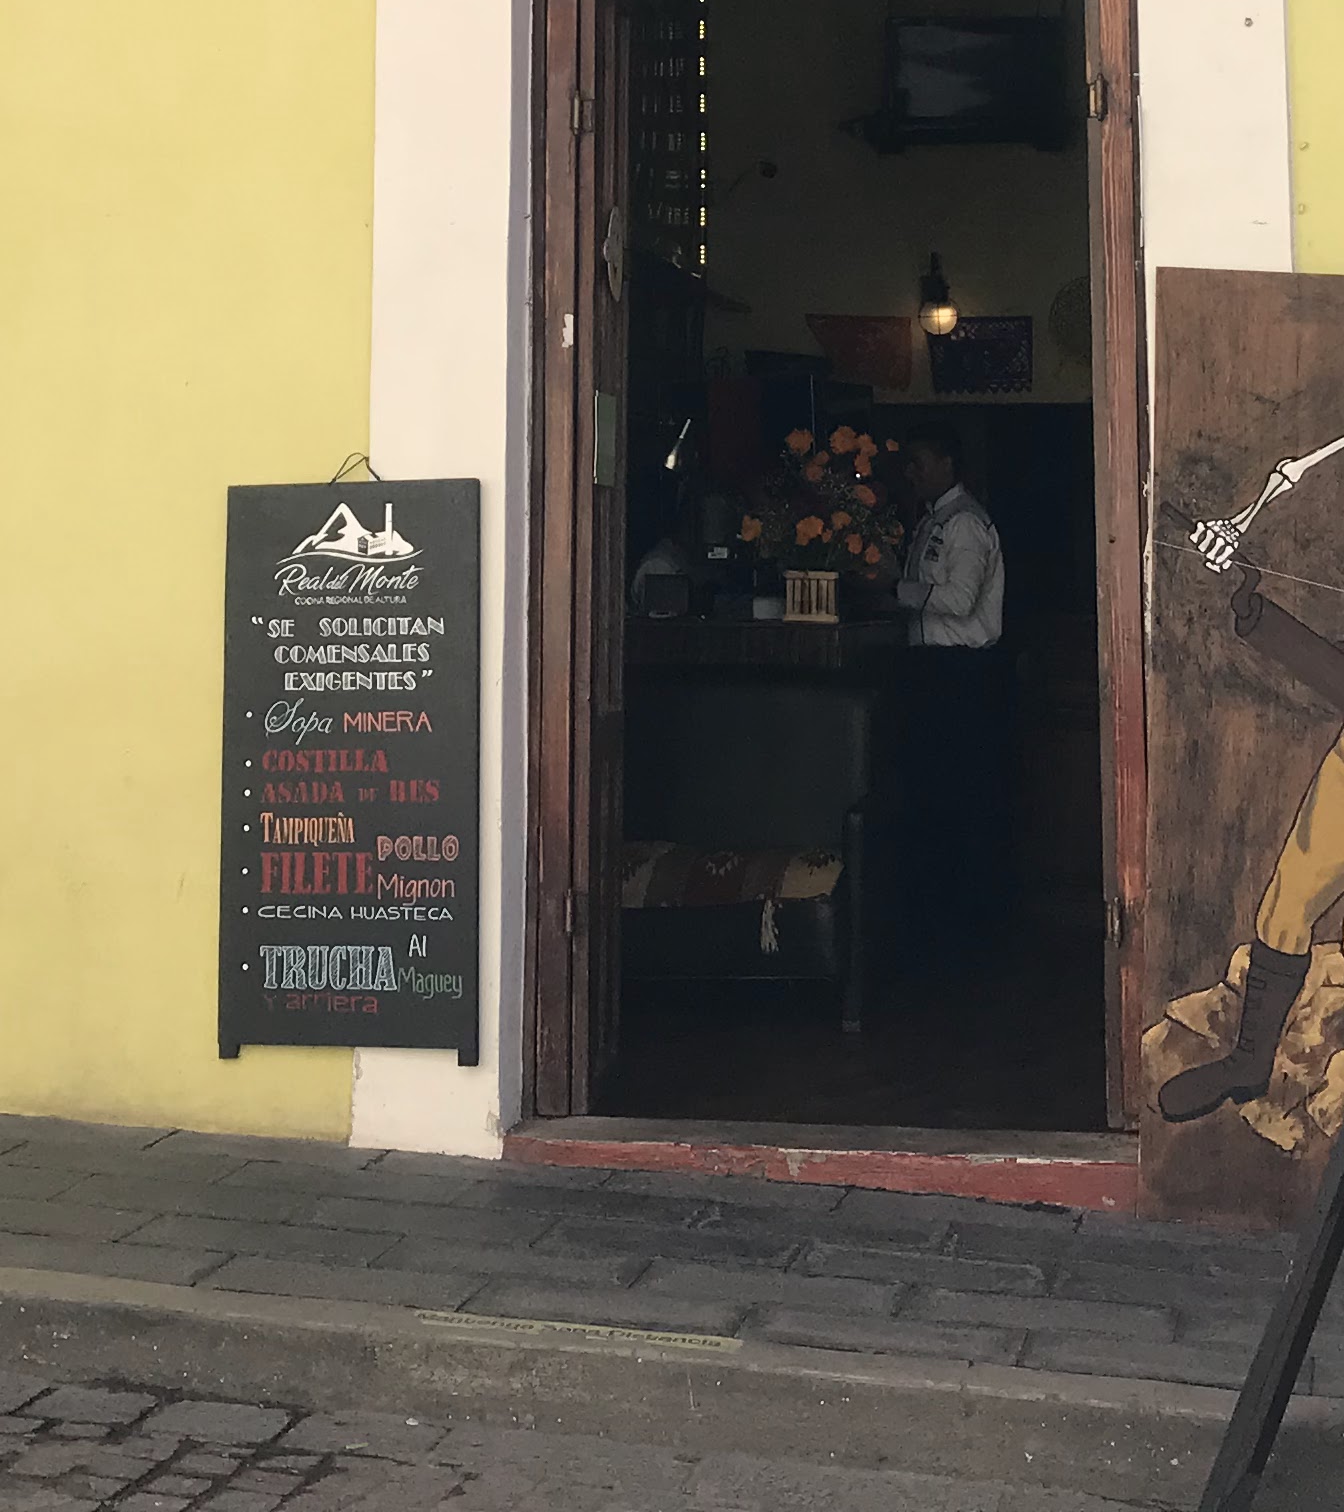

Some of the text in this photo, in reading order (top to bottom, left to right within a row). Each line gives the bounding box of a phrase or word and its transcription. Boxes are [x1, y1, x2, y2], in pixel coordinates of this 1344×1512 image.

[274, 563, 335, 596] Real
[339, 563, 425, 596] Monte
[319, 616, 445, 638] SOLICITAN
[274, 643, 430, 665] COMENSALES
[264, 698, 433, 746] Sopa MINERA
[262, 749, 389, 773] COSTILLA
[259, 781, 346, 804] ASADA
[389, 778, 441, 803] RES
[260, 834, 460, 896] FILETE POLLO
[376, 873, 456, 906] Mignon
[257, 905, 454, 921] CECINA HUASTECA
[259, 944, 464, 1000] TRUCHA Maguey
